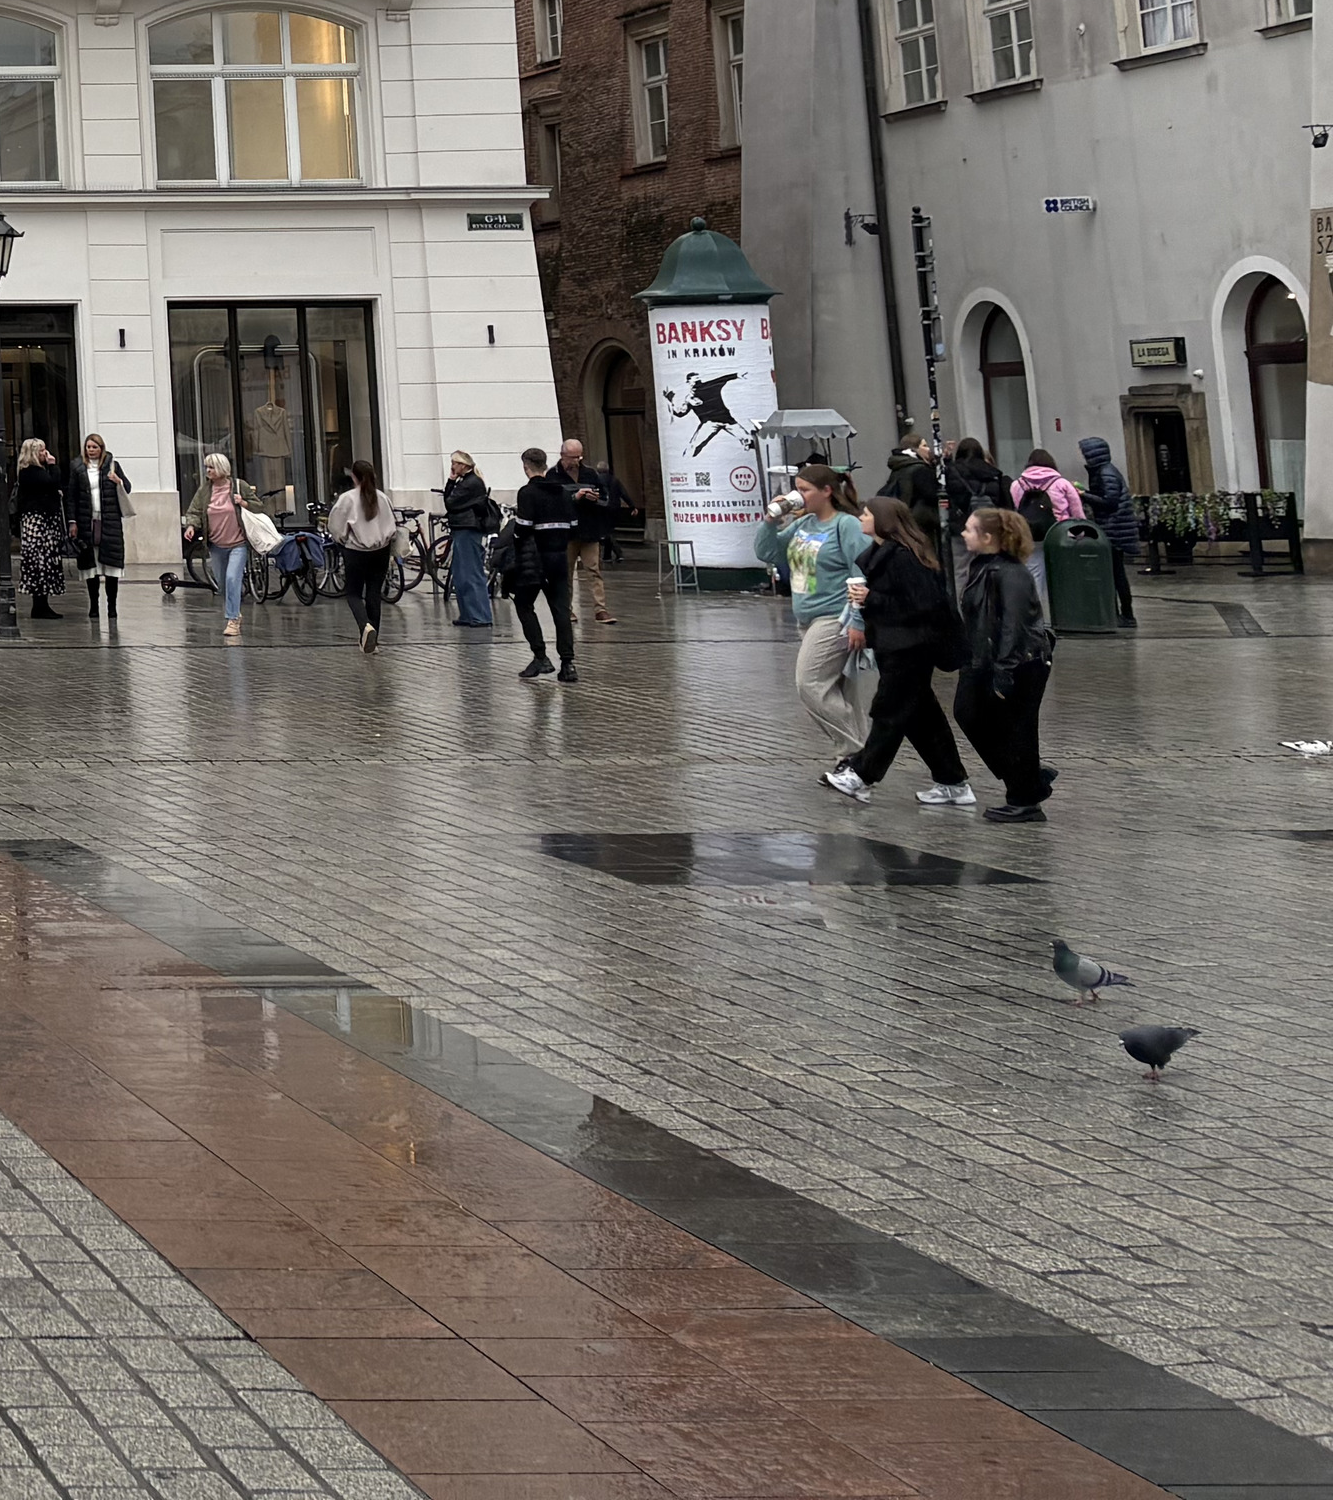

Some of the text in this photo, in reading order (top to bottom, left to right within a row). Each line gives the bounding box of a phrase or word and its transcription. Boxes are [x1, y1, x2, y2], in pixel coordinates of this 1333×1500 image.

[656, 319, 745, 344] BANKSY
[668, 344, 735, 359] IN KRAKÓW
